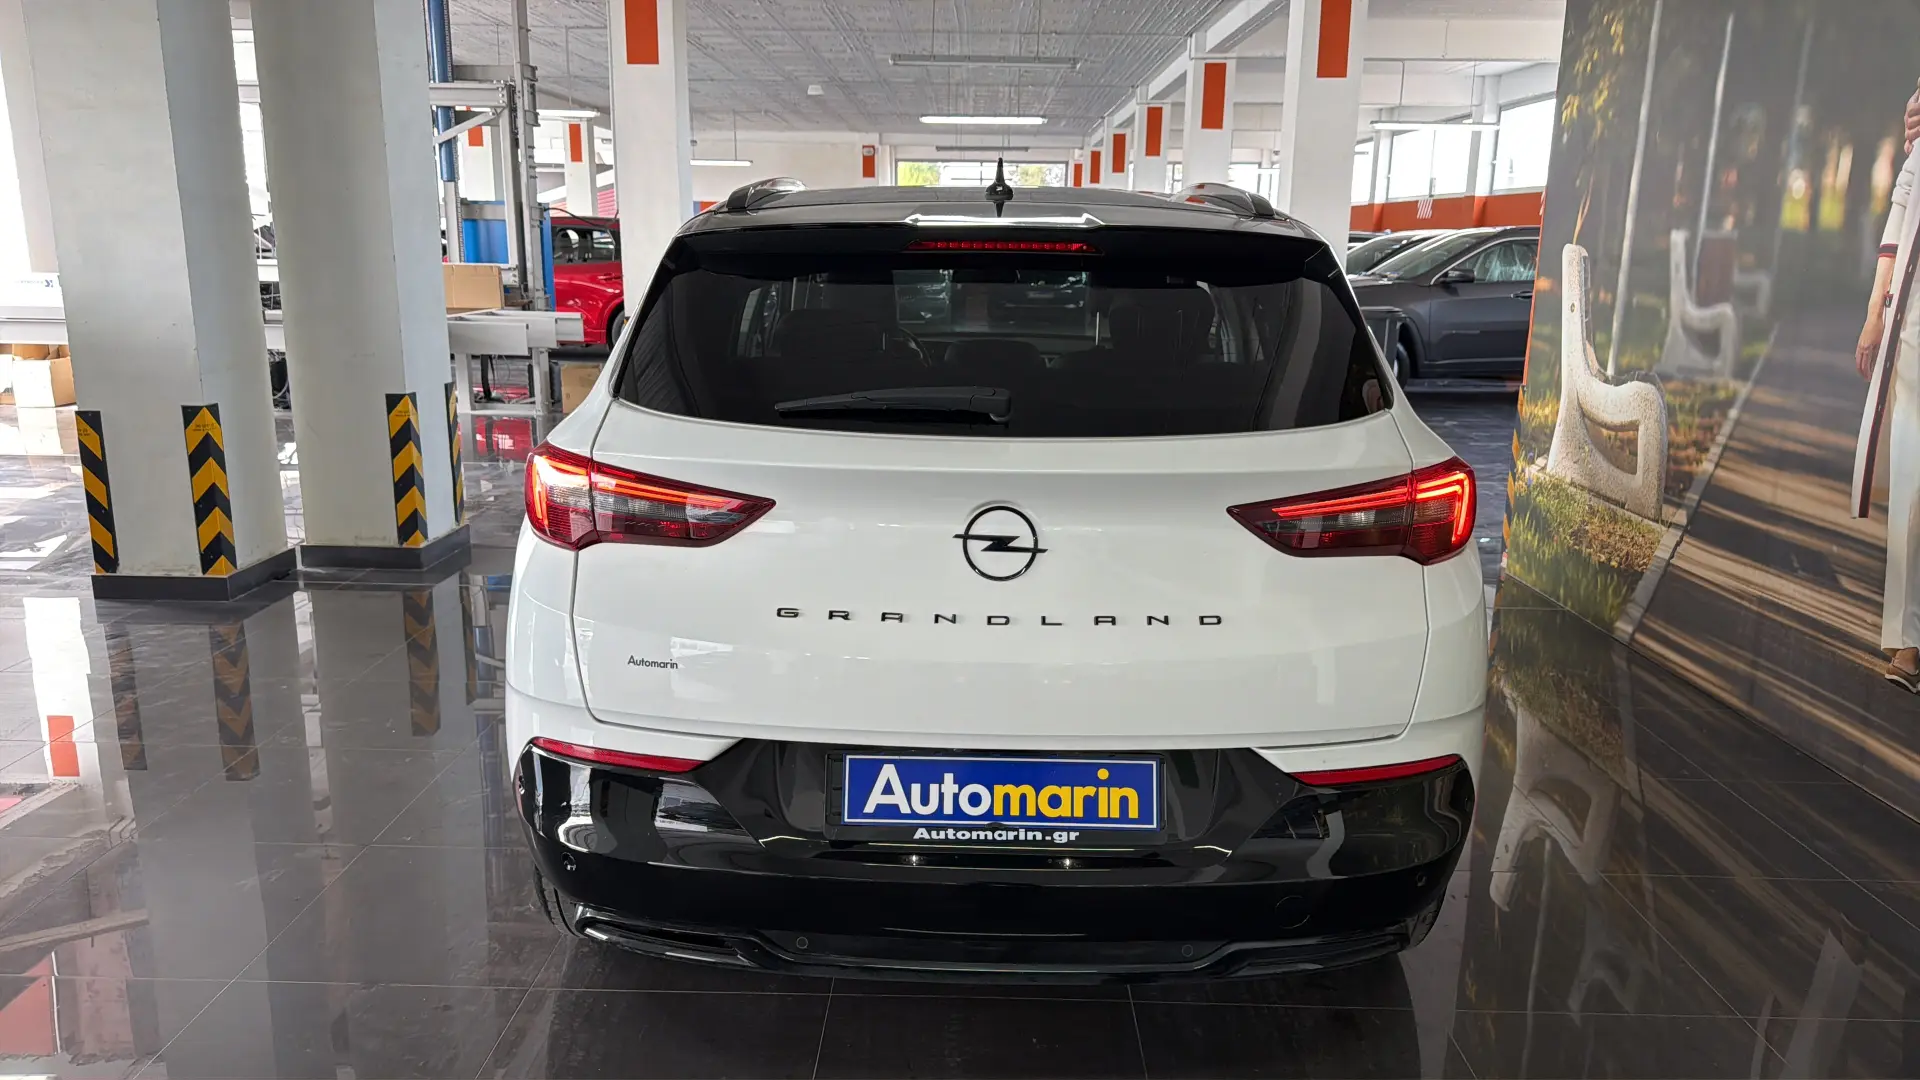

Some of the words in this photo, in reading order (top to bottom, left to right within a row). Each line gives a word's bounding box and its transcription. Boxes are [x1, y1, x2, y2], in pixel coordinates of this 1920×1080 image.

[776, 607, 1222, 626] GRANDLAND
[627, 655, 679, 669] Automarin
[863, 763, 1139, 819] Automarin
[913, 827, 1079, 843] Automarin.gr
